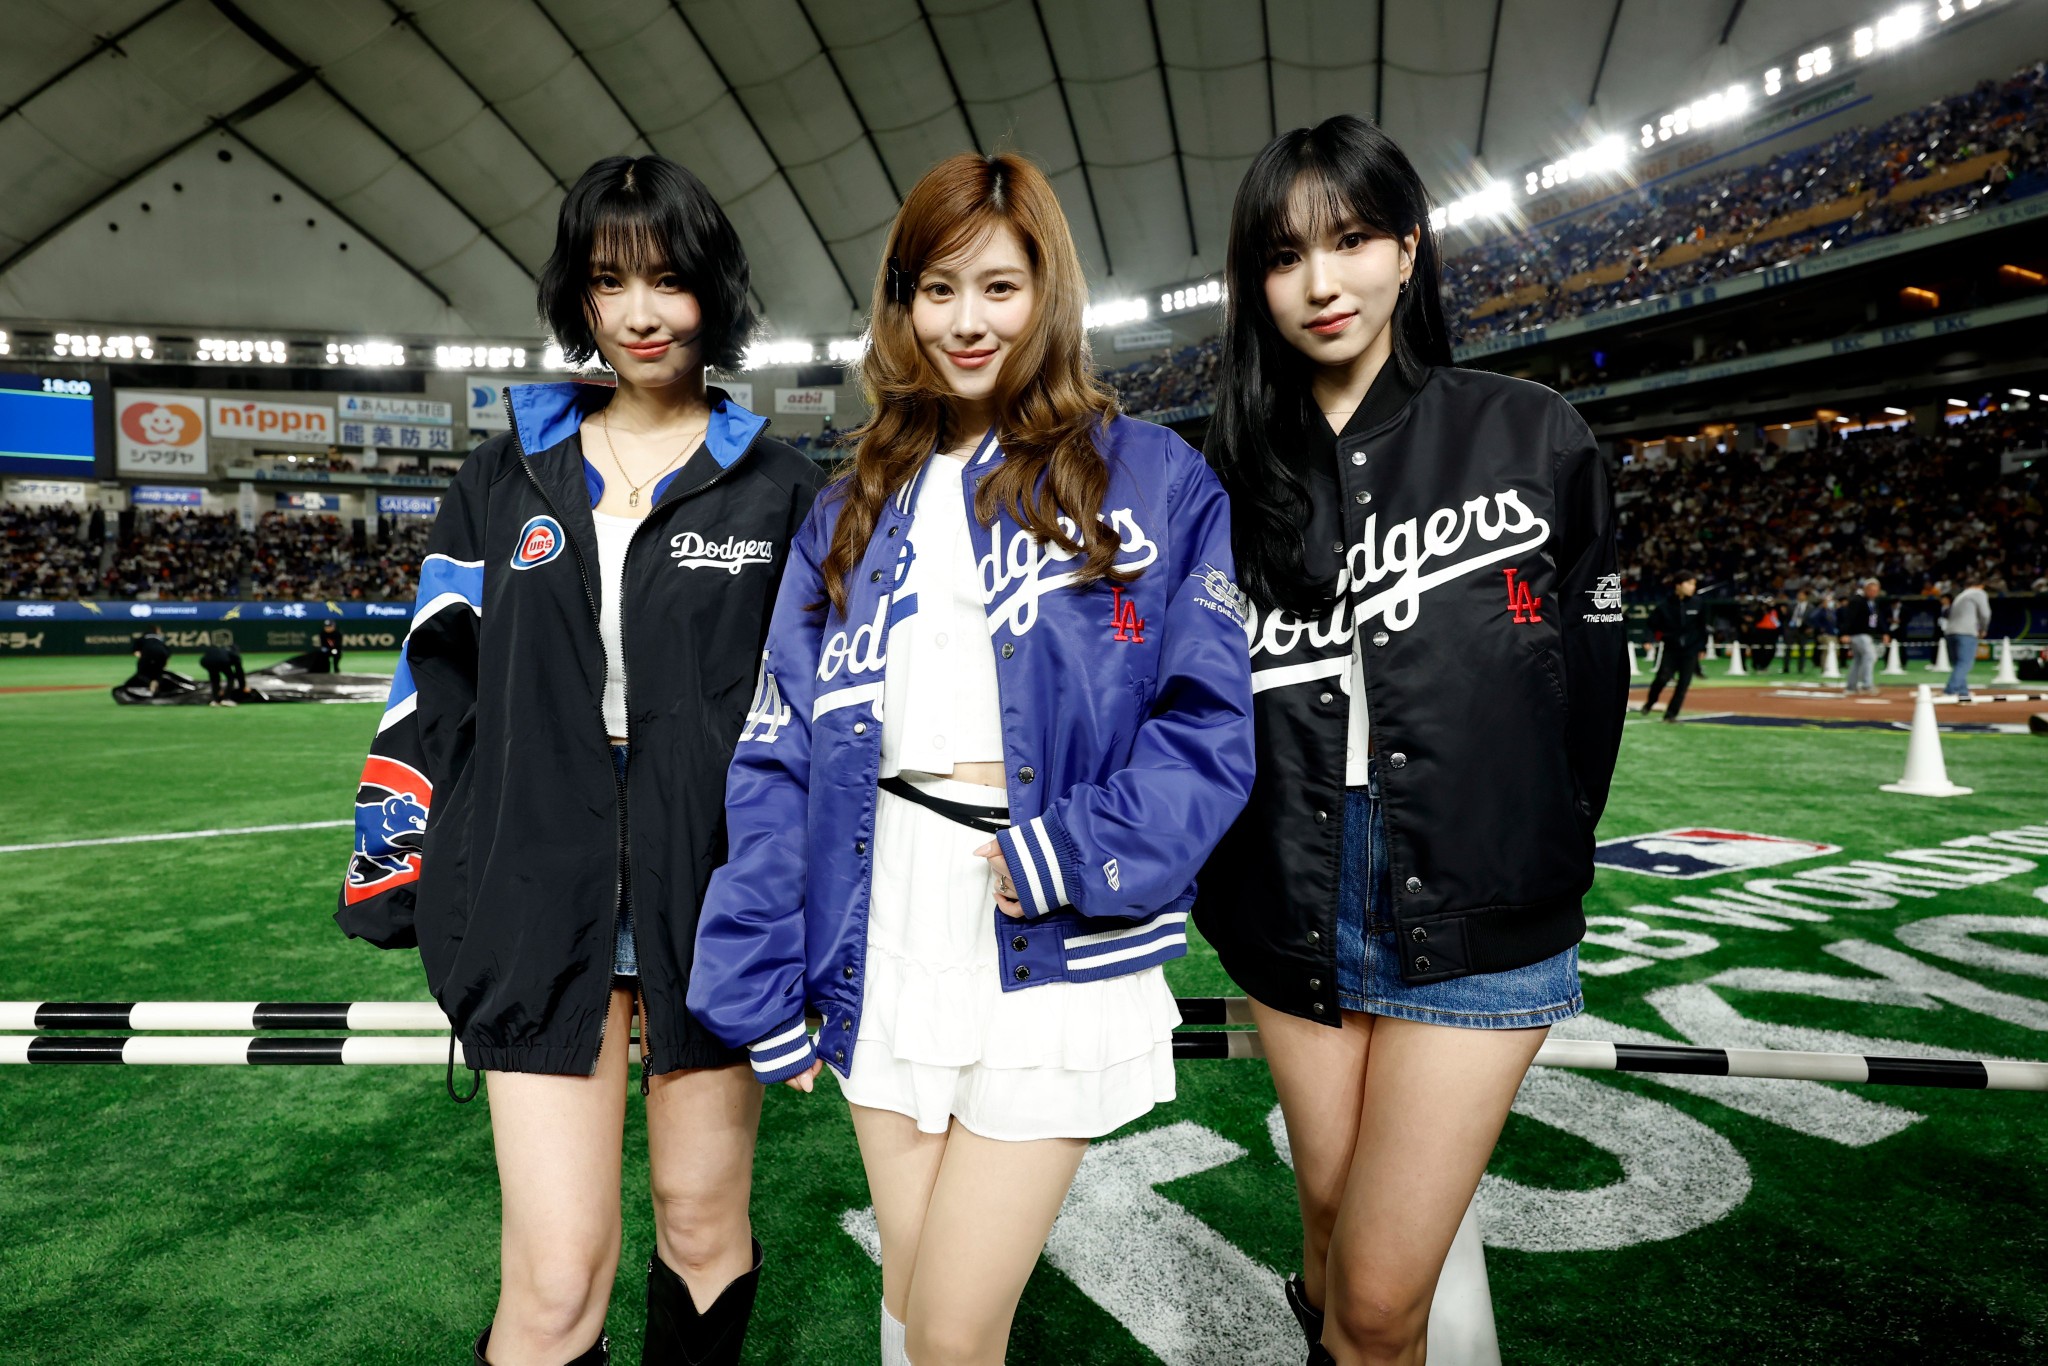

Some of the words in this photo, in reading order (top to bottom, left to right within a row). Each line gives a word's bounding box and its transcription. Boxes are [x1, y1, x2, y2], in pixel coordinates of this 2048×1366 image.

[1763, 262, 1800, 288] IHI
[1832, 333, 1864, 354] EKC
[1882, 324, 1916, 344] EKC
[1934, 314, 1971, 335] EKC
[43, 378, 92, 396] 18:00
[787, 389, 825, 406] azbil
[219, 403, 327, 434] nippn
[344, 425, 449, 449] 能美防災
[131, 449, 195, 465] シマダヤ
[379, 499, 433, 513] SAISON
[670, 531, 773, 575] Dodgers
[1503, 568, 1541, 623] LA
[1112, 586, 1146, 644] LA
[312, 633, 395, 648] SNKYO
[1627, 848, 2039, 932] WORLD
